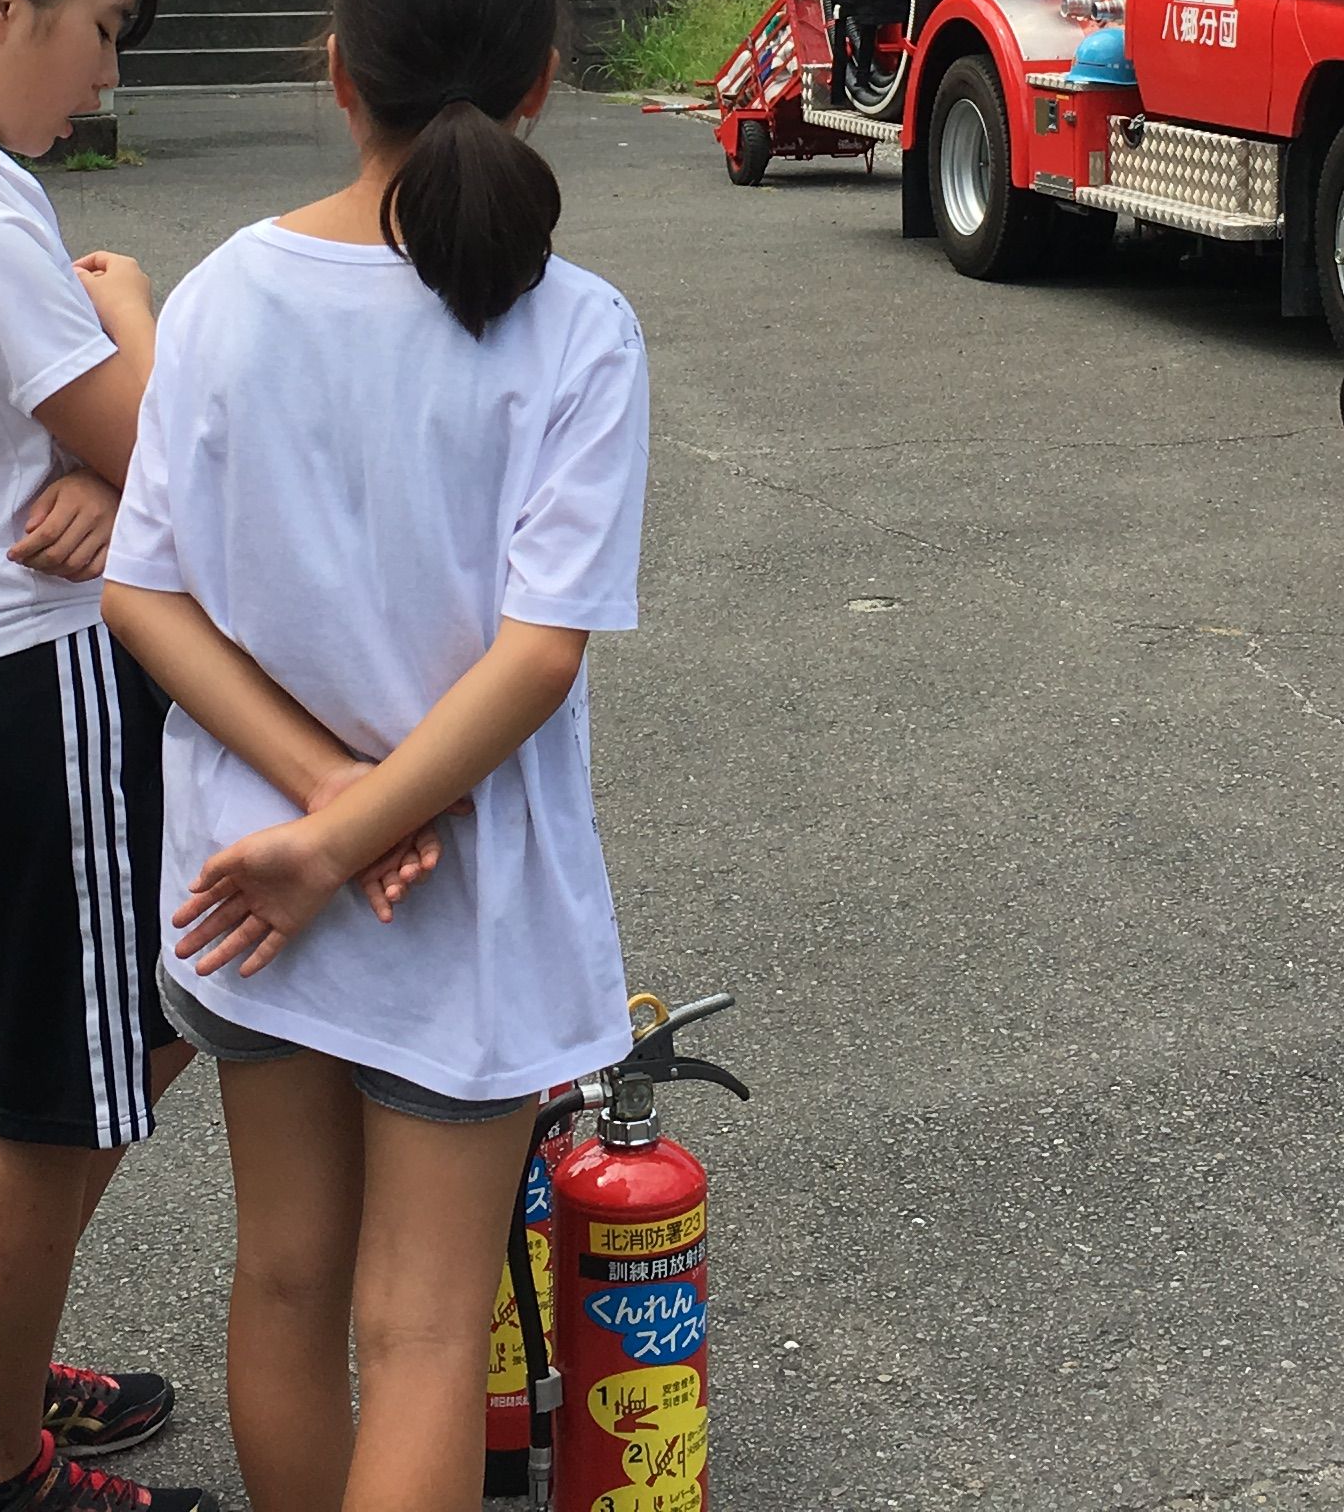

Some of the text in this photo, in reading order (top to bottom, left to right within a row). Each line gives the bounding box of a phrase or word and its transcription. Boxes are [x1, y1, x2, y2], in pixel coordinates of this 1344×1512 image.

[1161, 3, 1239, 48] 八郷分団
[601, 1211, 701, 1252] 北消防署23
[591, 1287, 693, 1325] くんれん
[633, 1311, 707, 1358] スイスイ
[596, 1386, 608, 1406] 1
[628, 1443, 644, 1463] 2
